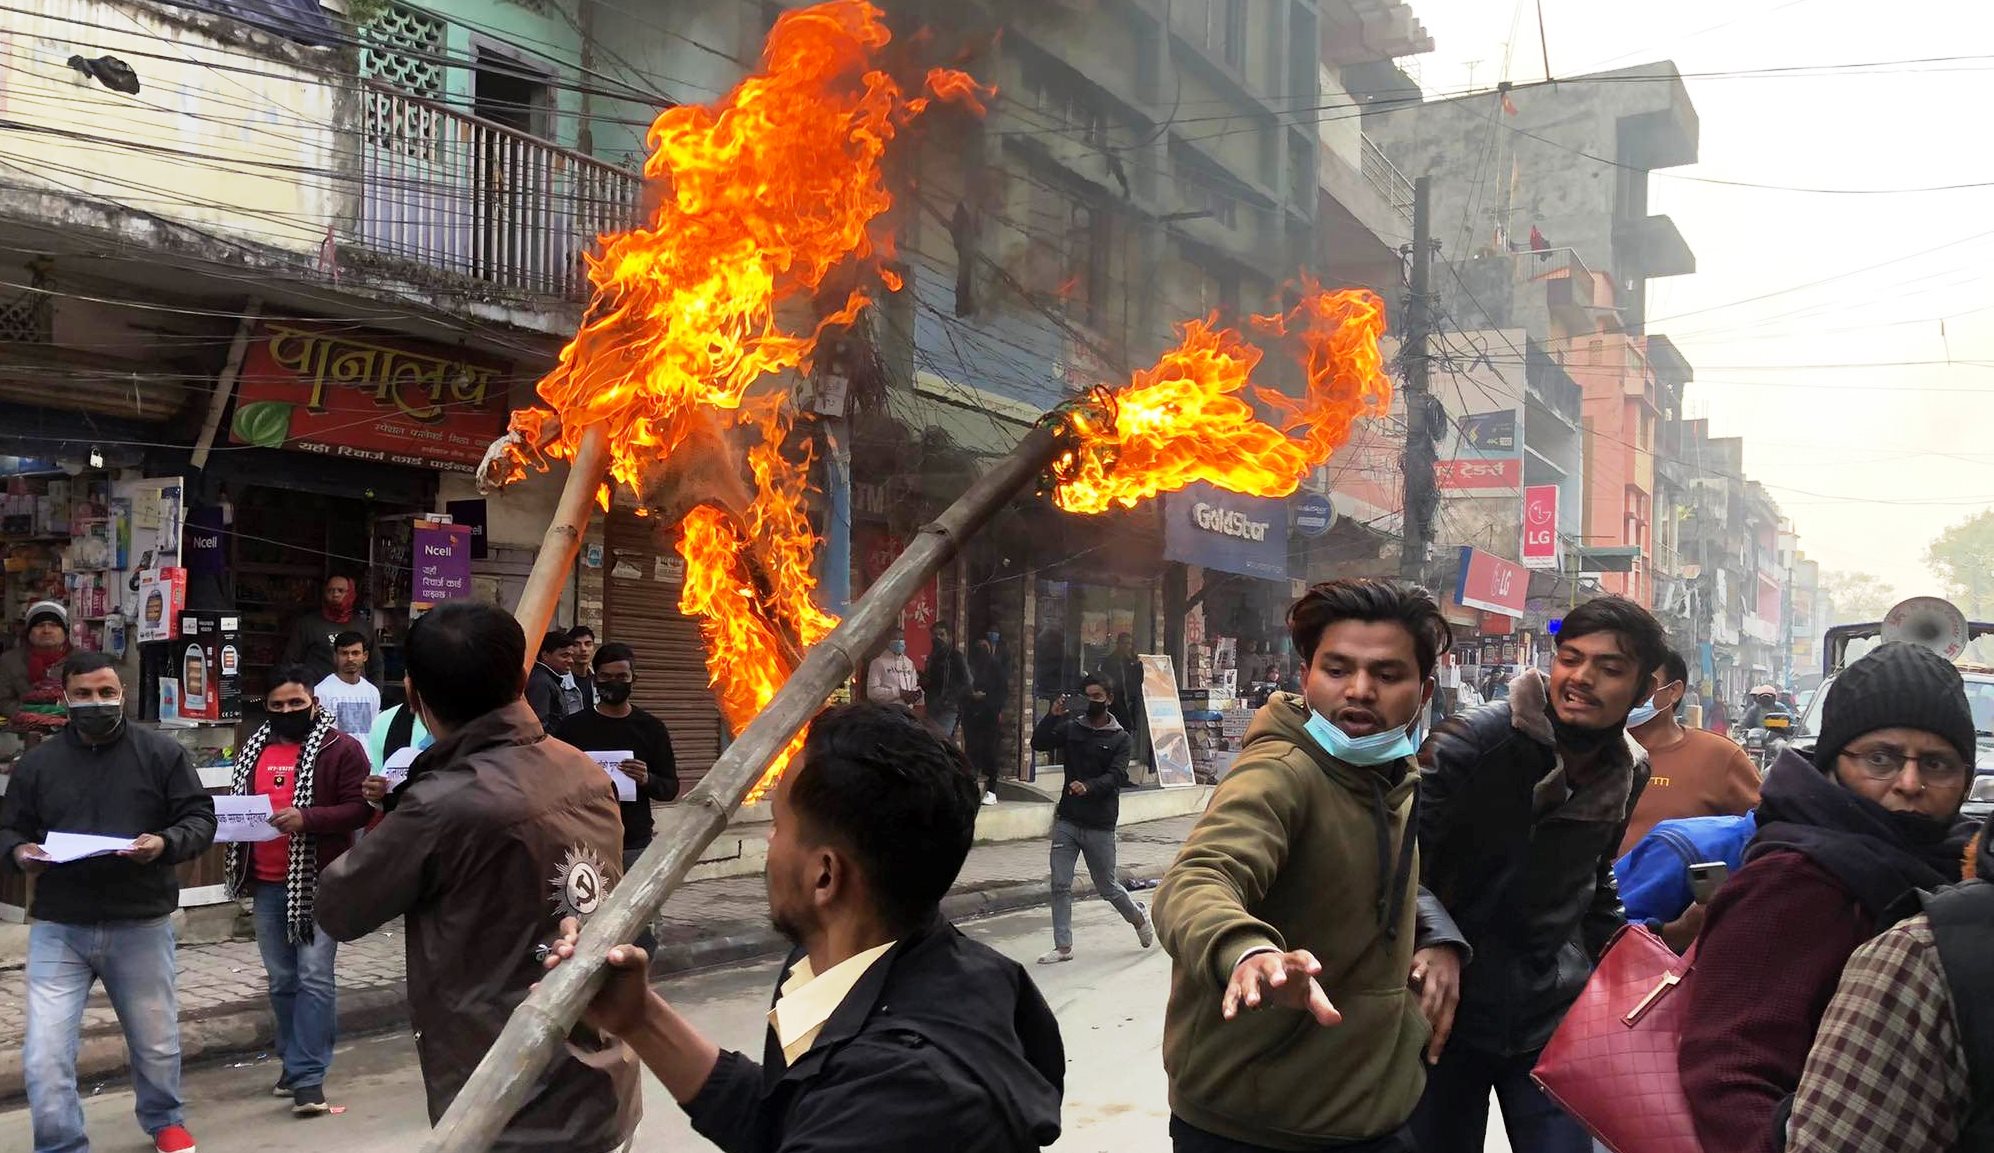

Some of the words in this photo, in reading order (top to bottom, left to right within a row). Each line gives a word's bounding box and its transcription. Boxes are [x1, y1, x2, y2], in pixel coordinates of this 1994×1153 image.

[1192, 502, 1270, 542] GoldStar
[193, 536, 217, 549] Ncell
[1529, 530, 1550, 545] LG
[425, 544, 451, 556] Ncell
[1499, 568, 1512, 596] LG
